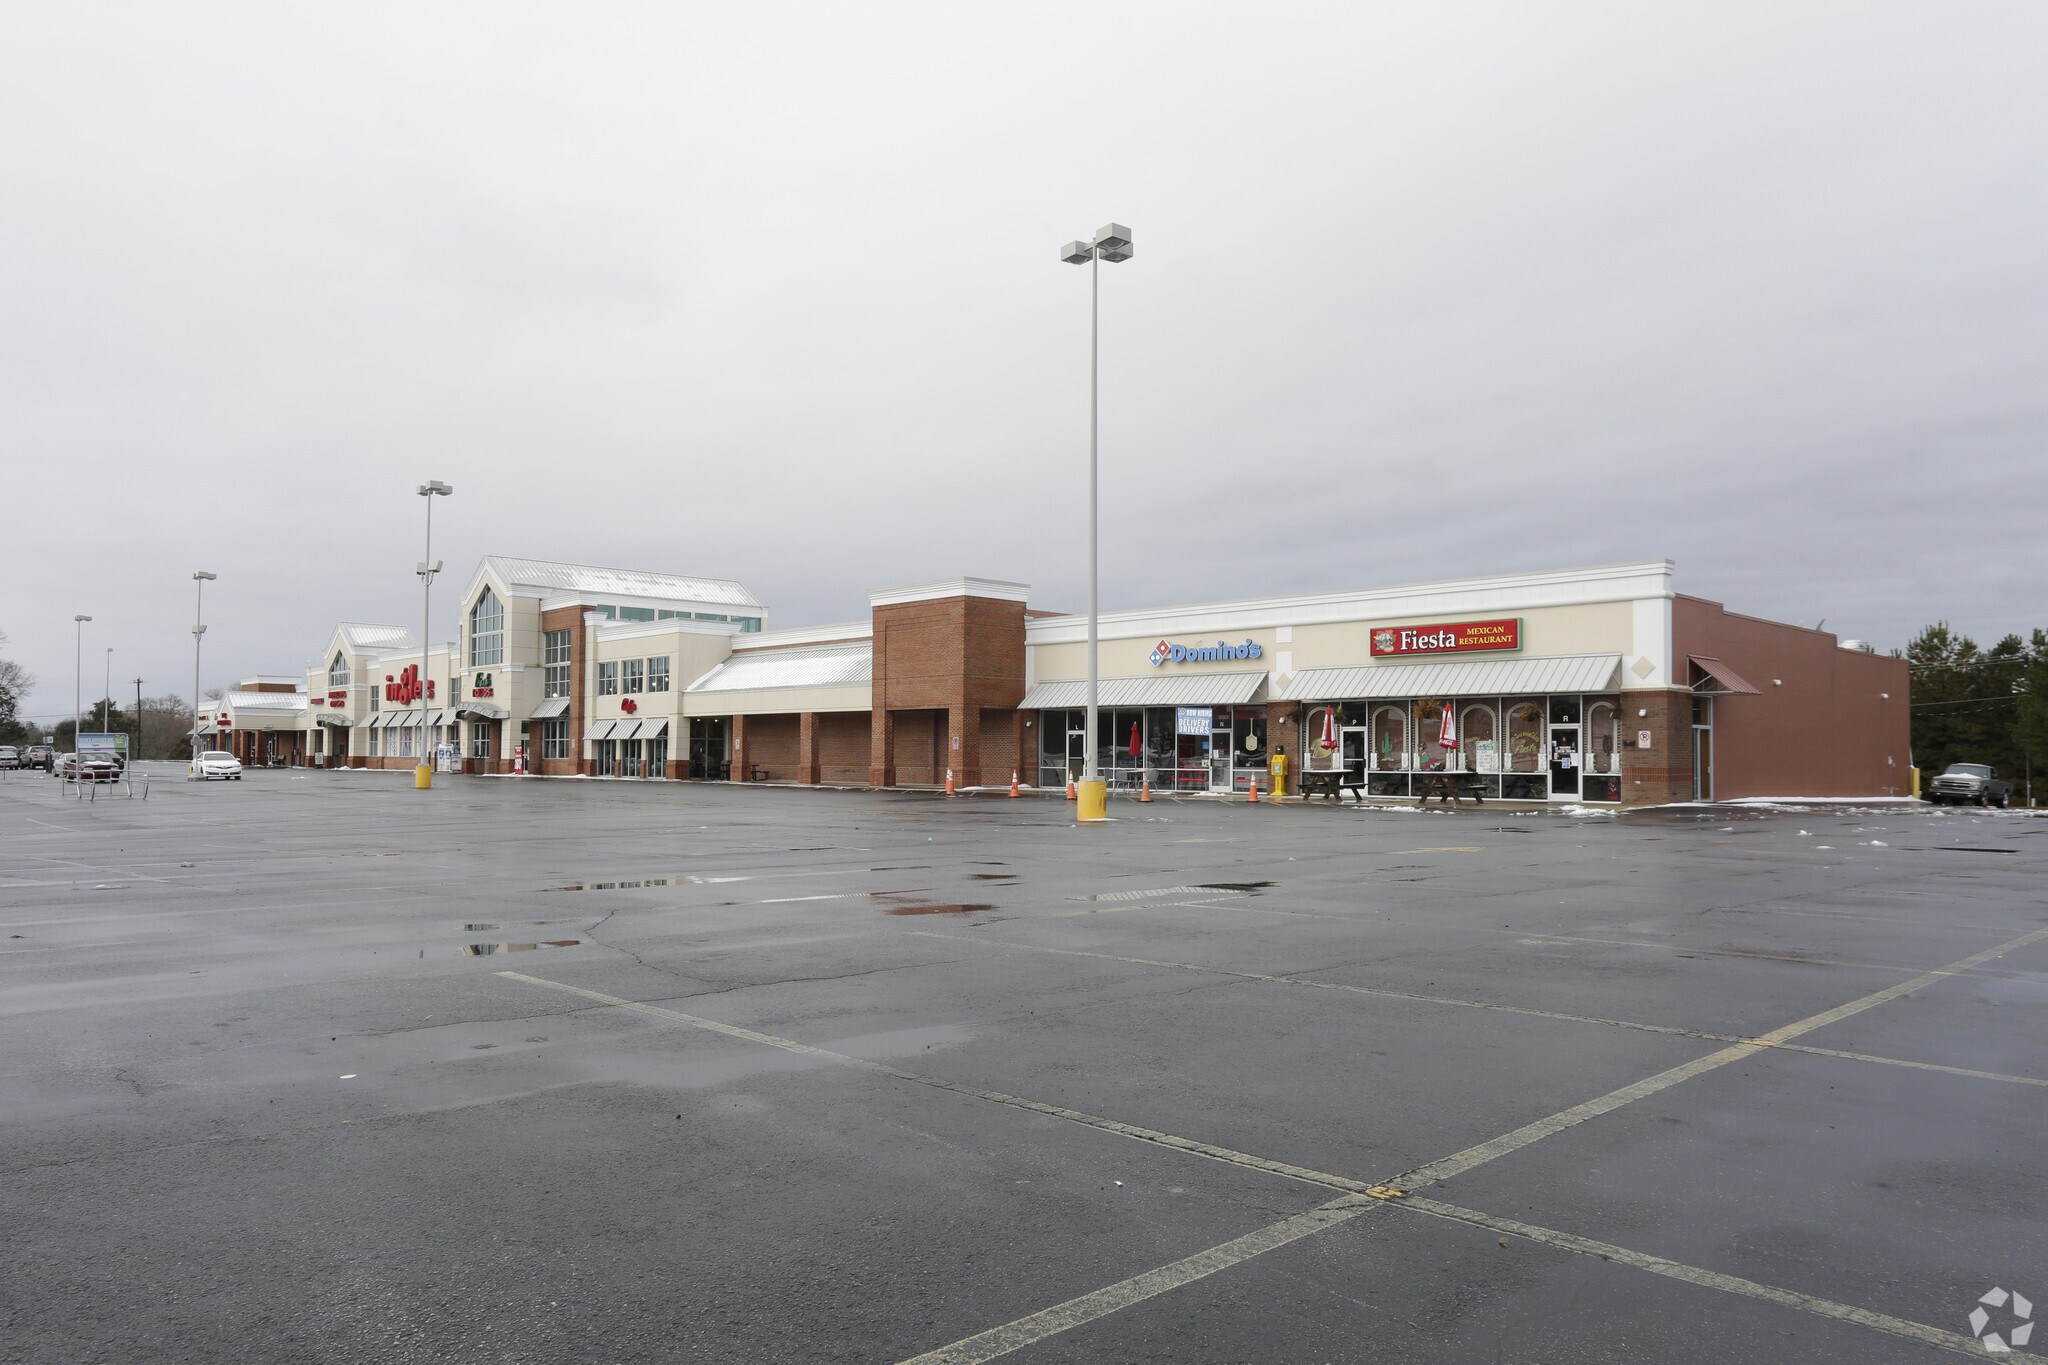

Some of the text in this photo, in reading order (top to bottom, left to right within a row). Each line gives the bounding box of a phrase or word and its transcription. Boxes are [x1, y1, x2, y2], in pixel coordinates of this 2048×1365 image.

[1466, 626, 1505, 636] MEXICAN
[1400, 629, 1456, 651] Fiesta
[1458, 634, 1513, 646] RESTAURANT
[1170, 638, 1263, 663] Domino's
[1178, 718, 1210, 727] DELIVERY
[1178, 725, 1210, 734] DRIVERS
